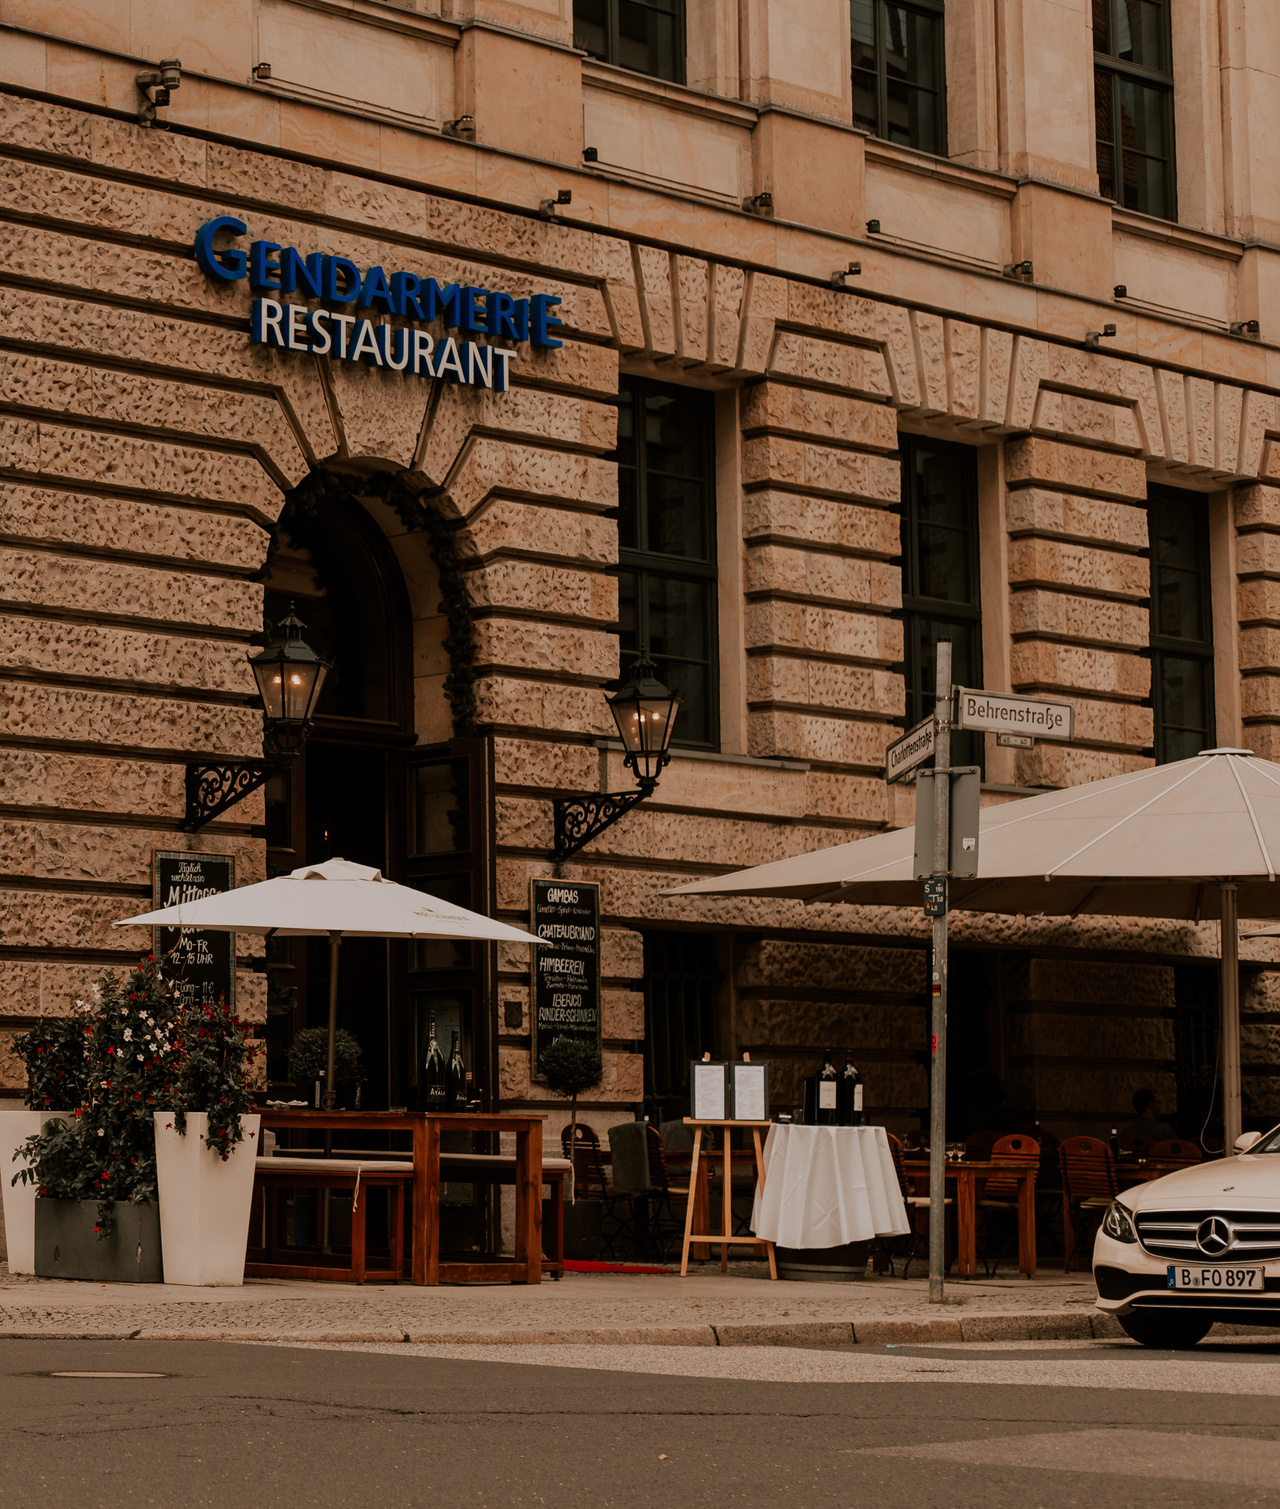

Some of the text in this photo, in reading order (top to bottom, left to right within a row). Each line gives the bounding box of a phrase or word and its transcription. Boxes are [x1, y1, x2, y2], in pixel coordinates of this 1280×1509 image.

[194, 216, 563, 349] GENDARMERIE
[254, 297, 517, 392] RESTAURANT
[967, 698, 1063, 730] Behrenstraße
[547, 887, 579, 904] GAMBAS
[537, 924, 596, 941] CHATEAUBRIAND
[196, 953, 213, 965] UHR
[539, 956, 585, 975] HIMBEEREN
[552, 993, 583, 1007] IBERICO
[1181, 1268, 1192, 1286] B
[1225, 1269, 1256, 1287] 897
